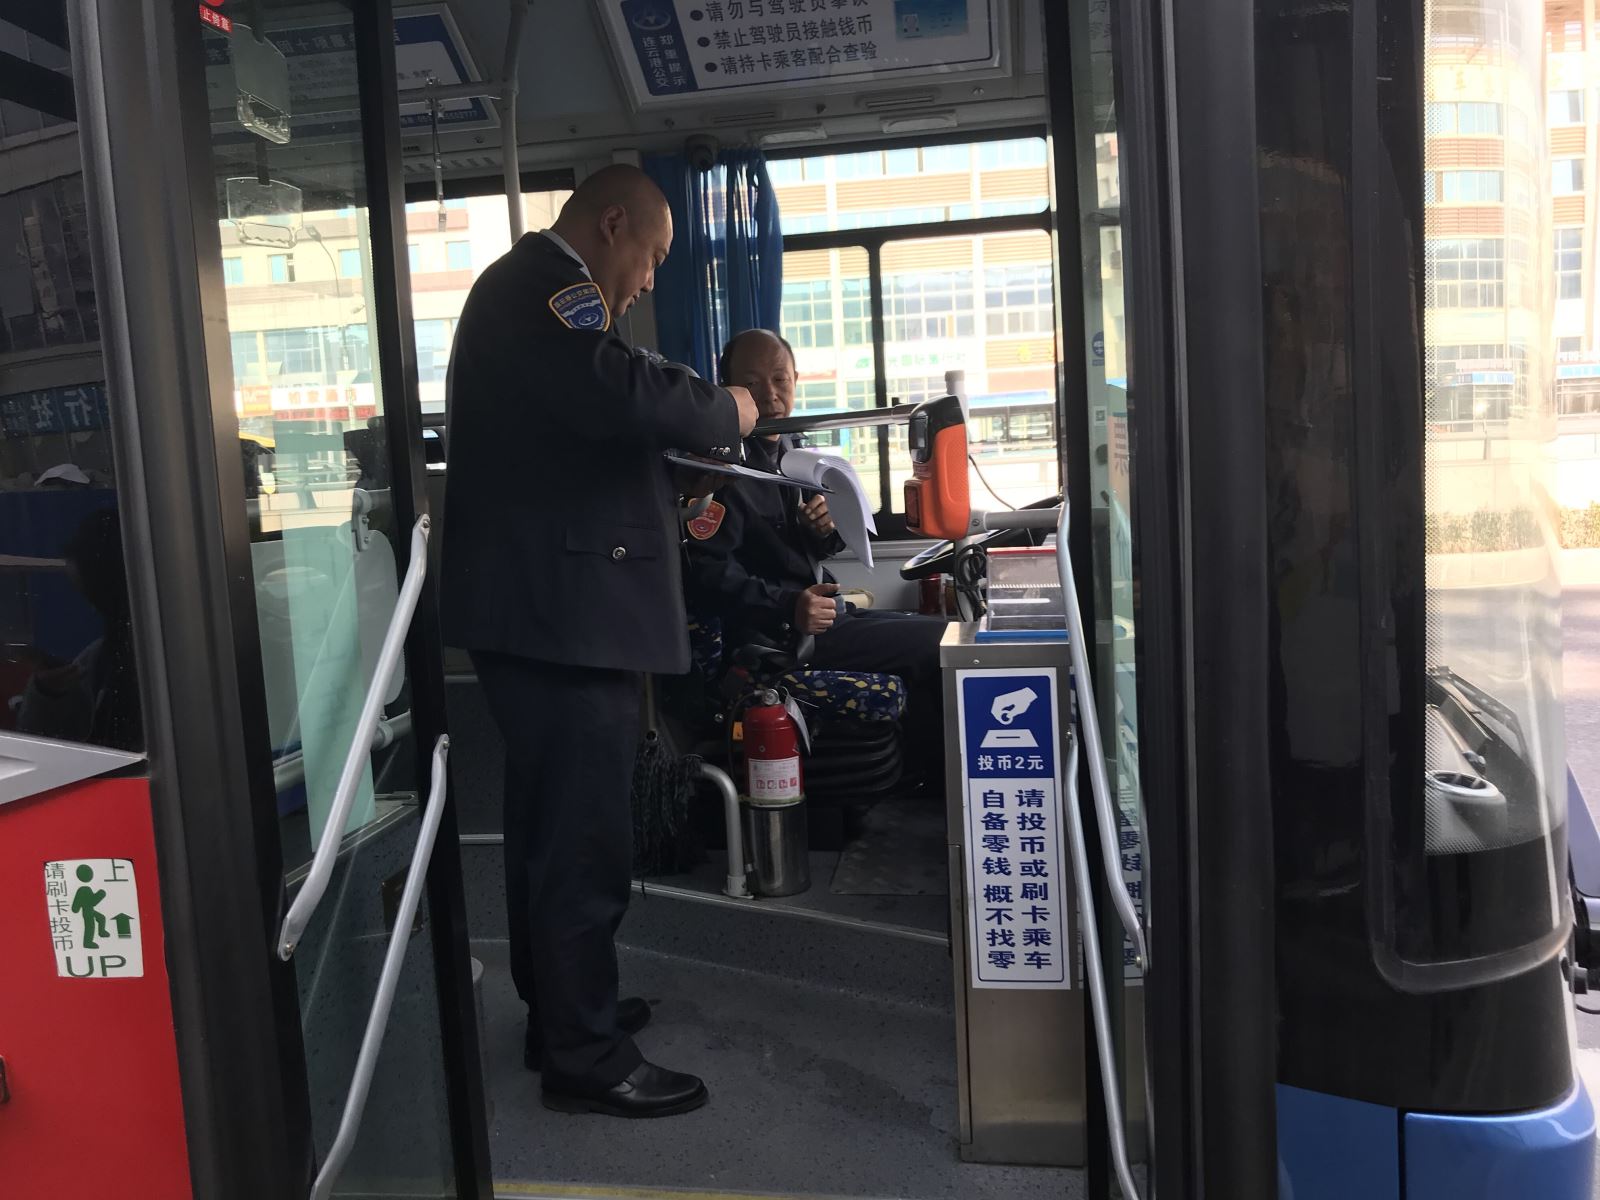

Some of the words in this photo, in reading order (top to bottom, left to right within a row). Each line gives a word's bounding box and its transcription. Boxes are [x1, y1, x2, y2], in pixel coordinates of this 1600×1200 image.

[713, 13, 872, 50] 禁止驾驶员接触钱币
[659, 34, 687, 87] 郑重提示
[721, 41, 878, 75] 请持卡乘客配合查验
[978, 754, 1044, 771] 投币2元
[104, 859, 129, 882] 上
[1014, 788, 1053, 969] 请投币或刷卡乘车
[45, 862, 74, 951] 请刷卡投币
[65, 955, 127, 977] UP
